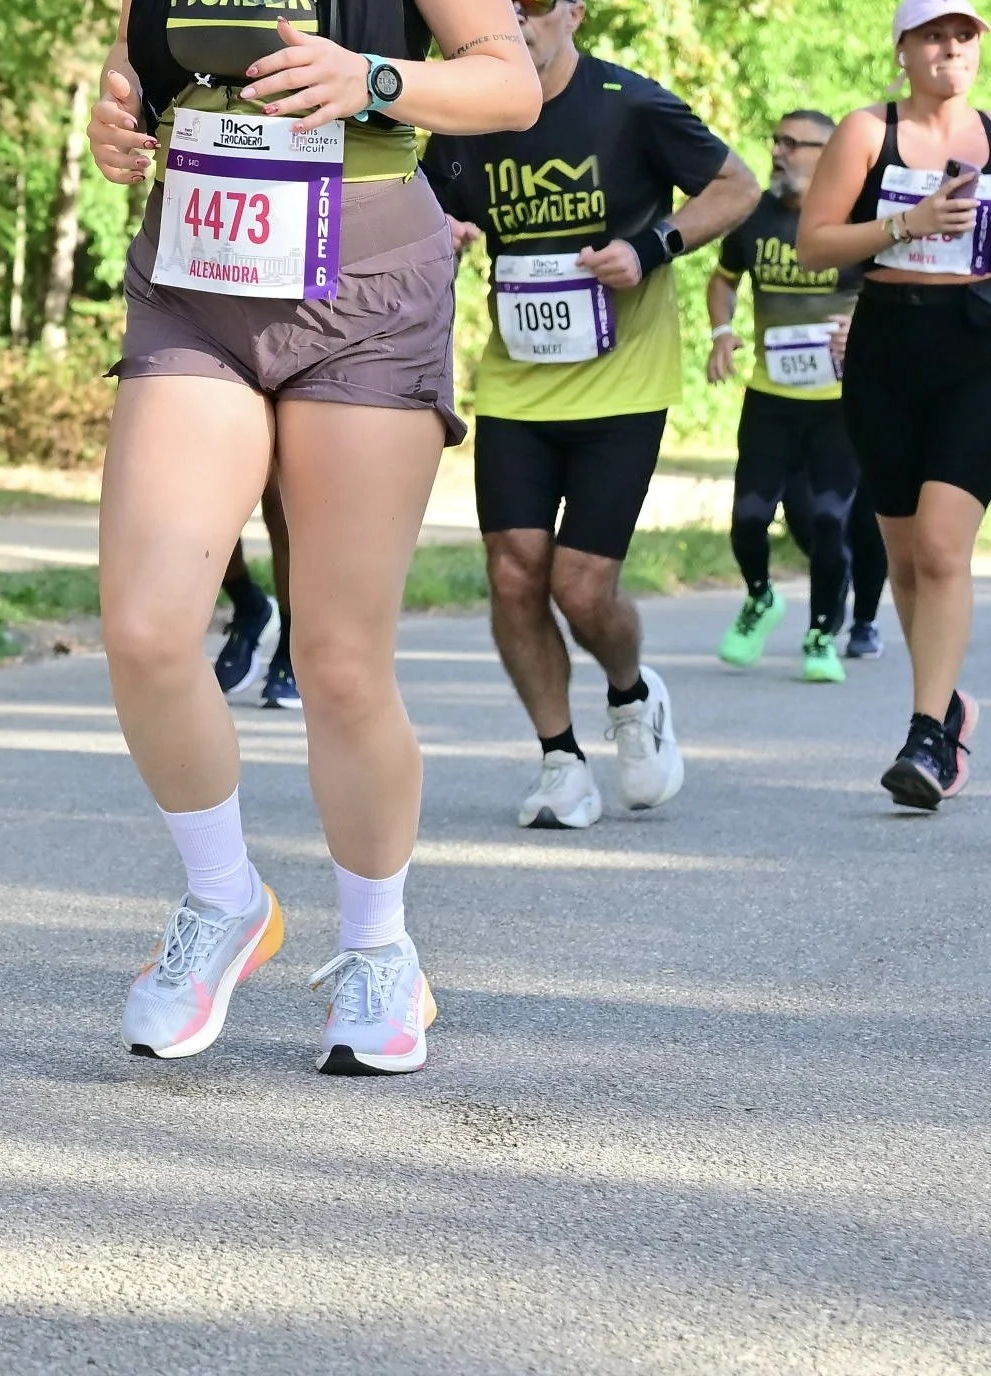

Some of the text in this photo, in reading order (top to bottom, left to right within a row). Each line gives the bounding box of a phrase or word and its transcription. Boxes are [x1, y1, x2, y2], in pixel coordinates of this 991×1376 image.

[219, 133, 264, 147] TROCADERO
[220, 118, 264, 136] 10KM
[484, 154, 600, 205] 10KM
[184, 187, 270, 245] 4473
[487, 189, 605, 233] TROCADERO
[315, 176, 331, 288] ZONE 6
[755, 236, 798, 265] 10K
[189, 259, 259, 284] ALEXANDRA
[514, 300, 571, 332] 1099
[779, 353, 819, 374] 6154
